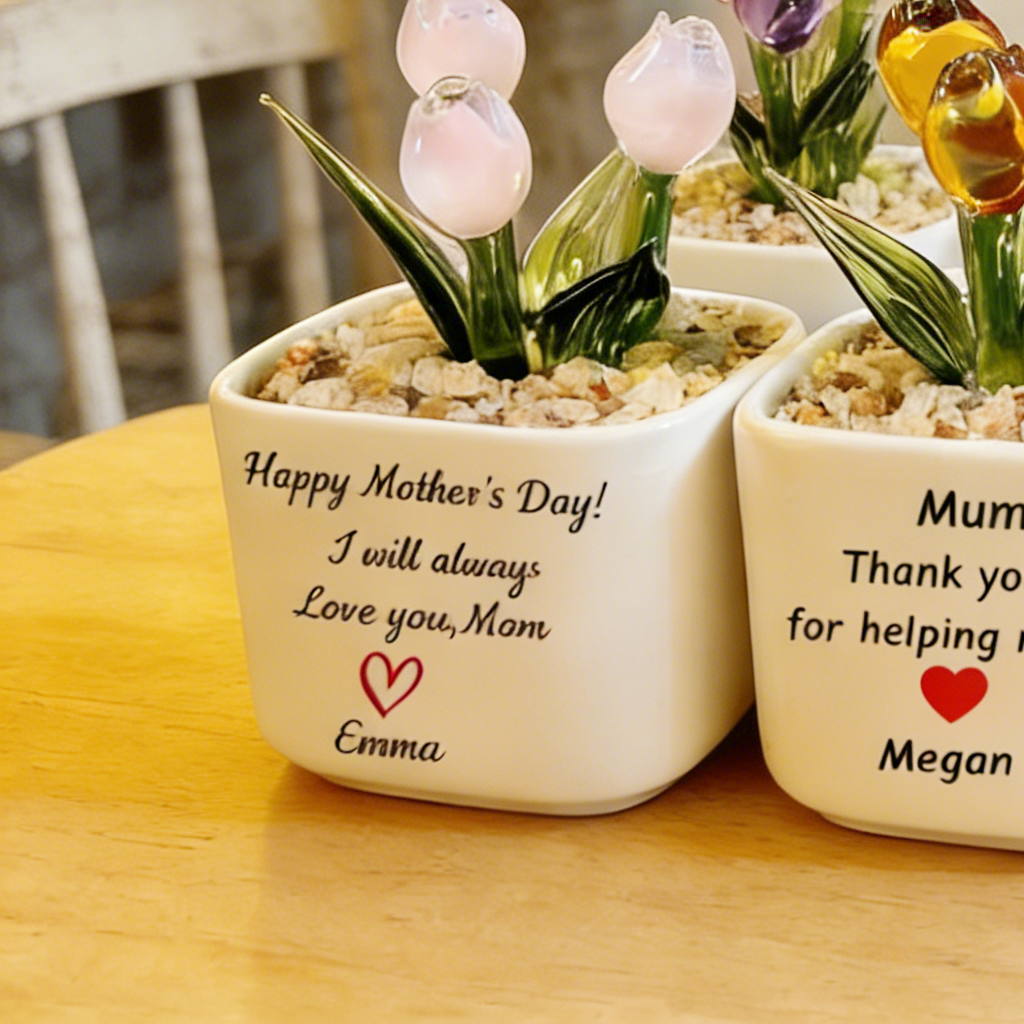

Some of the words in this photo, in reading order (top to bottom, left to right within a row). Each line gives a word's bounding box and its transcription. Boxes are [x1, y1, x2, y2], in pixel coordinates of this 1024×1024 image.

[243, 450, 351, 512] Happy
[359, 462, 505, 510] Mother's
[516, 478, 609, 535] Day!
[327, 529, 359, 565] I
[361, 535, 424, 572] will
[430, 541, 541, 600] always
[841, 549, 963, 590] Thank
[291, 584, 377, 626] Love
[786, 606, 845, 643] for
[859, 609, 1000, 663] helping
[333, 718, 447, 763] Emma
[877, 737, 1013, 785] Megan
